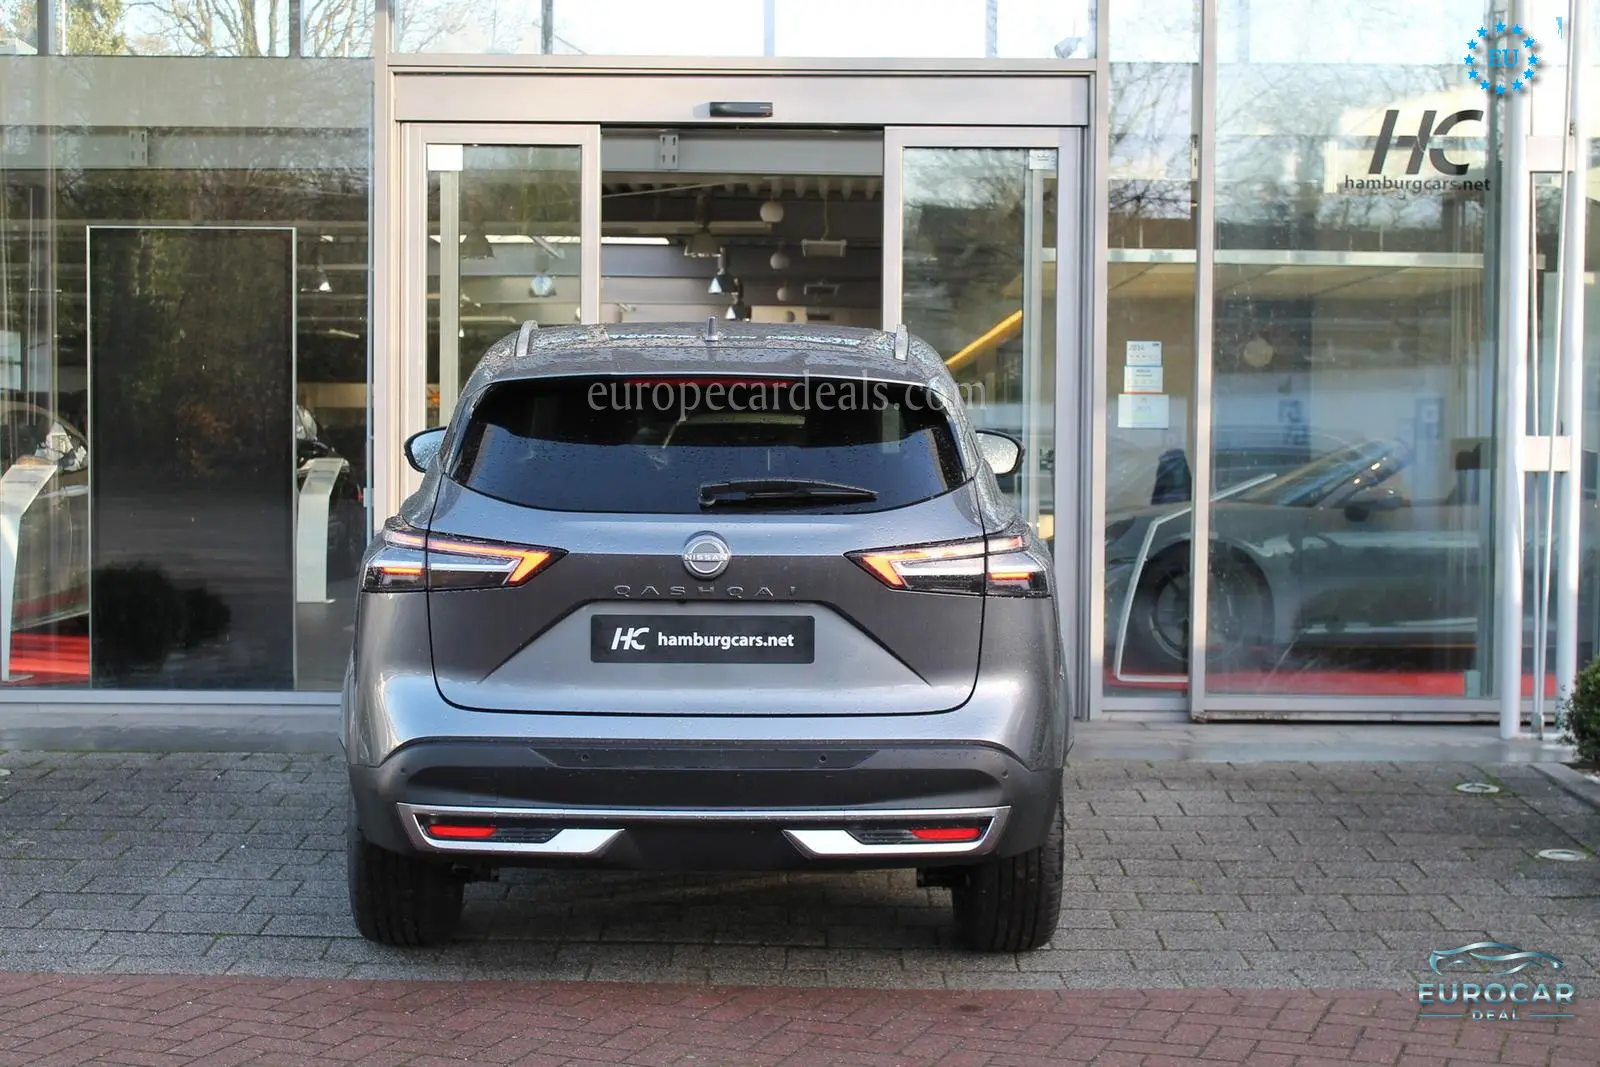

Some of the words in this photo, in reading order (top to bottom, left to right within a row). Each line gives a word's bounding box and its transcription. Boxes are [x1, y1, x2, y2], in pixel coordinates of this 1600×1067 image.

[1368, 109, 1484, 176] HC
[1344, 175, 1491, 193] hamburgcars.net
[684, 553, 728, 561] NISSAN
[613, 585, 797, 599] QASHQAI
[611, 627, 650, 650] HC
[657, 632, 795, 650] hamburgcars.net
